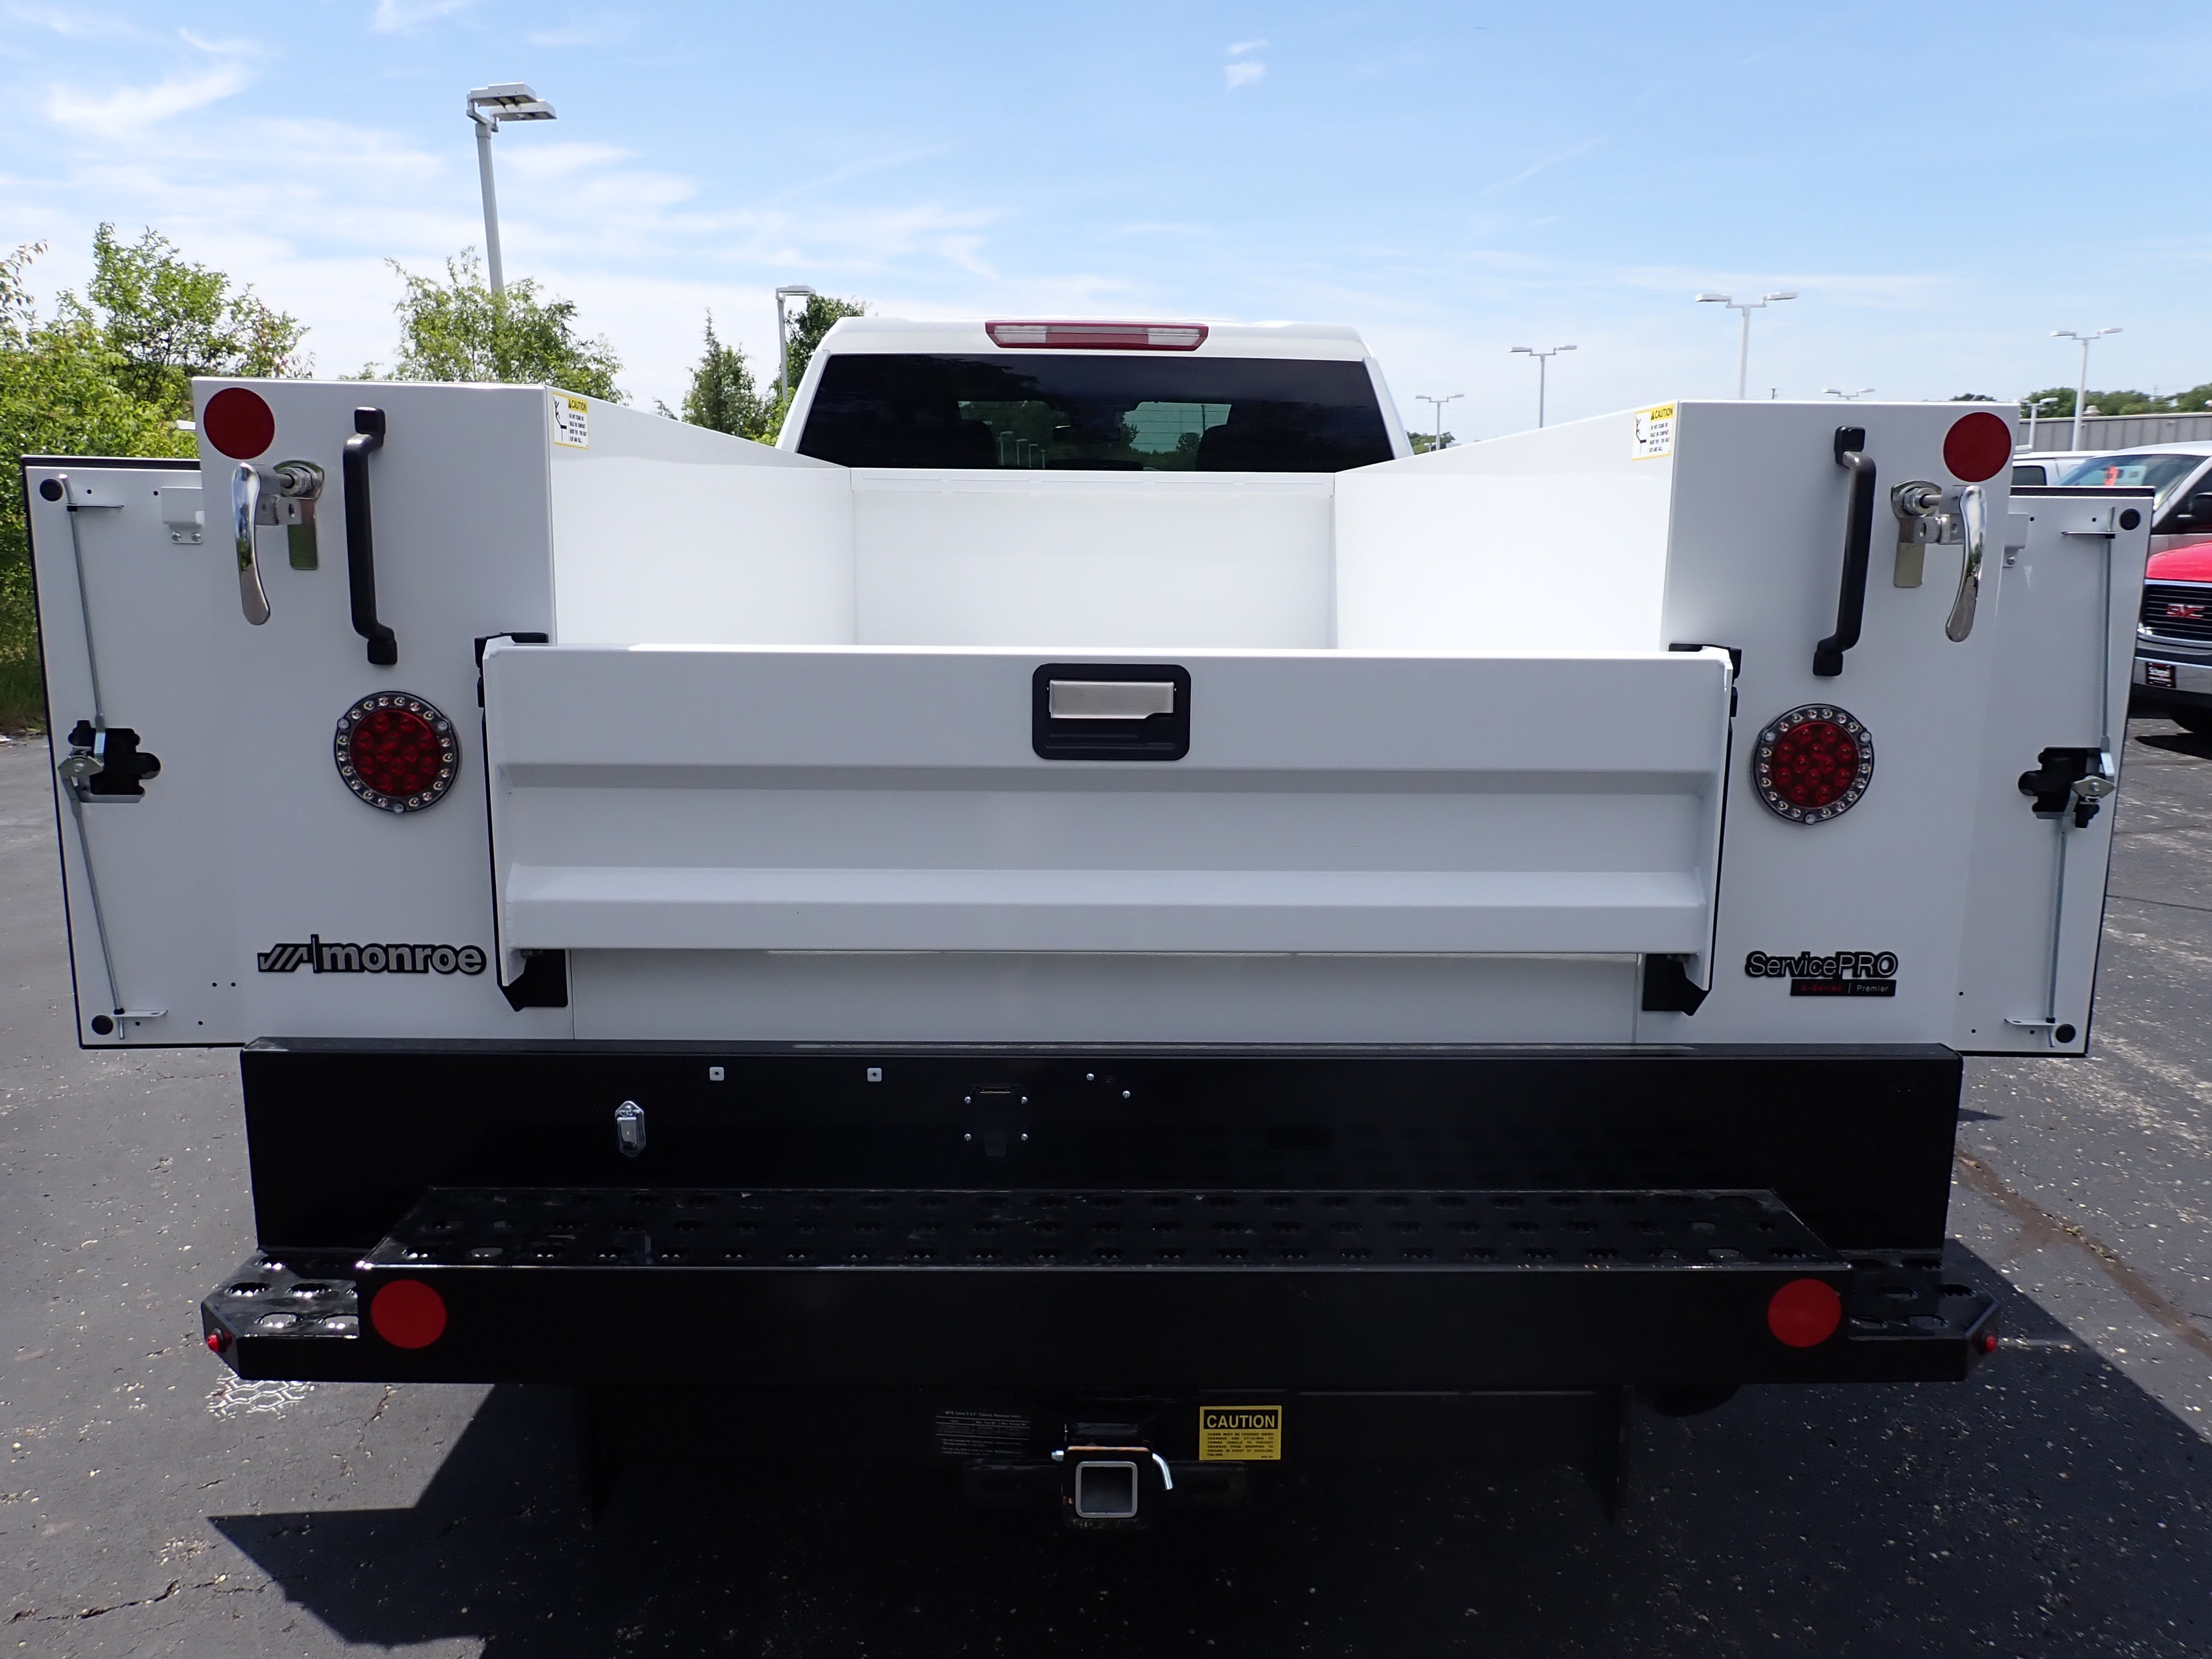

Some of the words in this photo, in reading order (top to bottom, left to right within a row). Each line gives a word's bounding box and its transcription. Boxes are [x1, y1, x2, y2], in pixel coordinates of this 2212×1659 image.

[1655, 407, 1672, 418] CAUTION
[2167, 603, 2204, 619] GMC
[322, 943, 487, 975] monroe
[1745, 951, 1898, 977] ServicePRO
[1856, 984, 1889, 993] Premier
[1207, 1415, 1275, 1428] CAUTION
